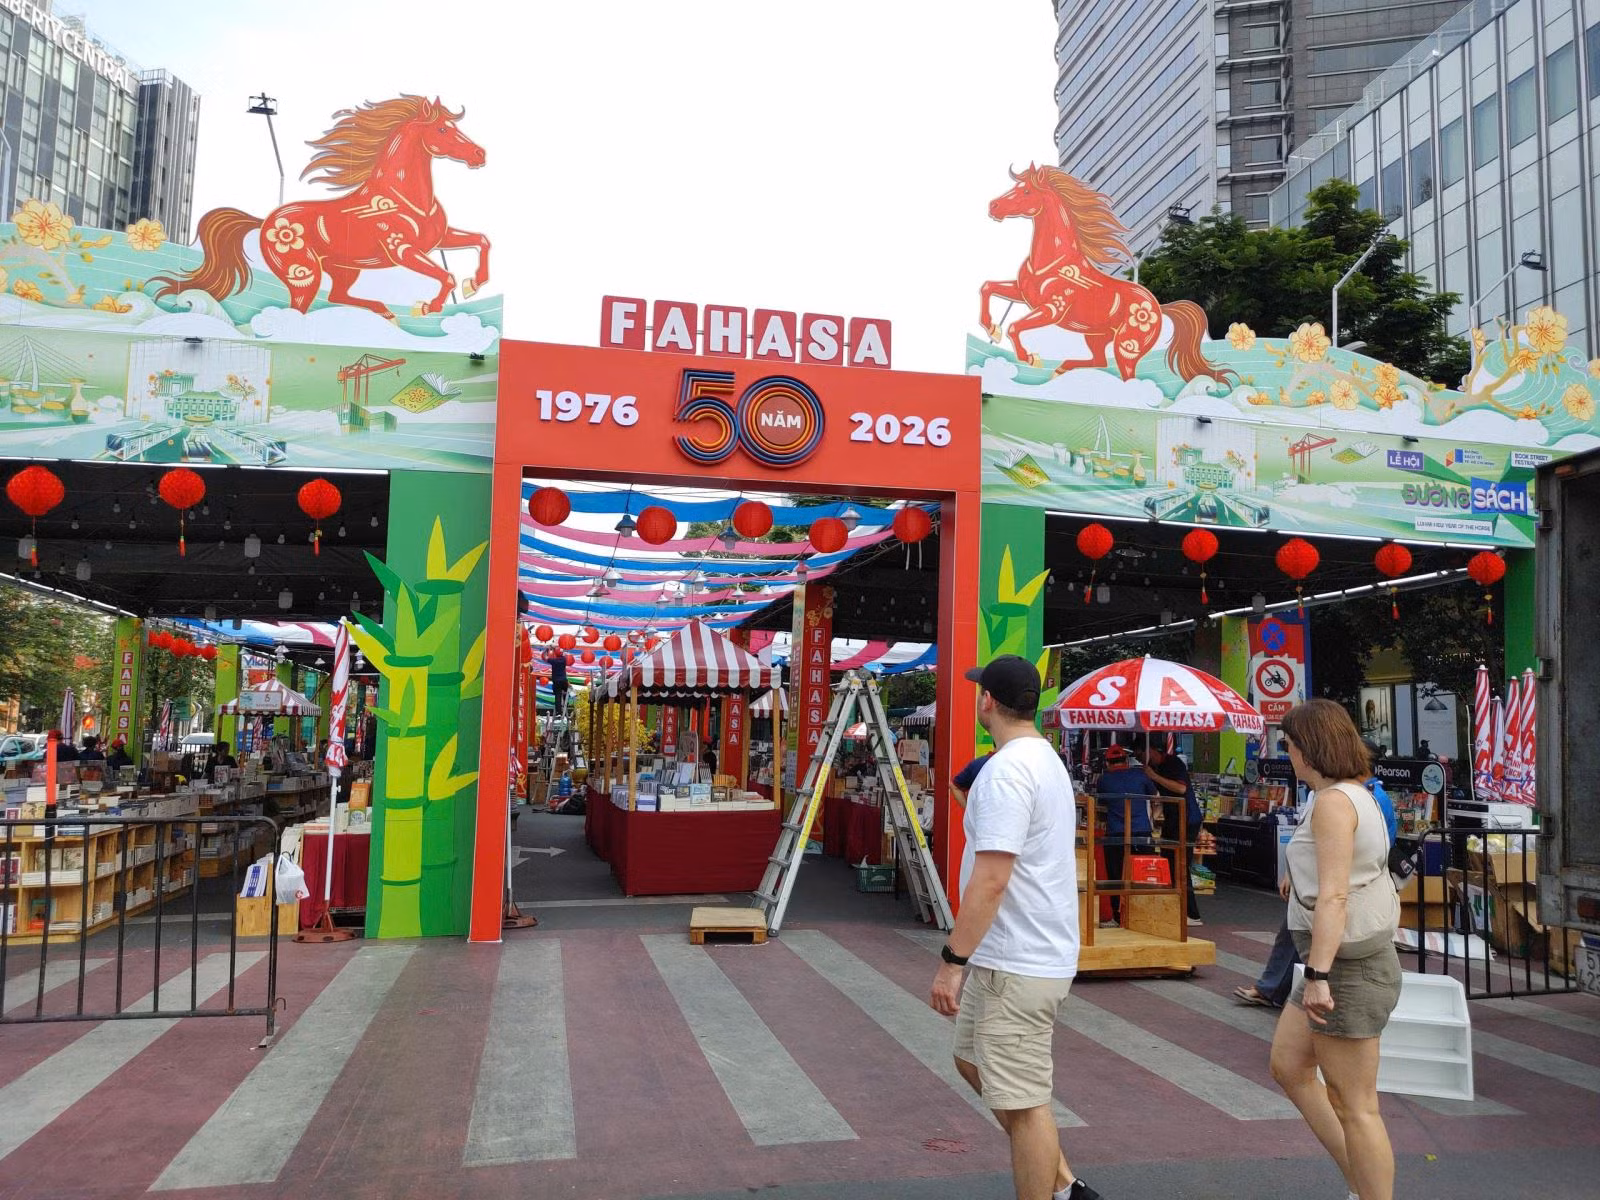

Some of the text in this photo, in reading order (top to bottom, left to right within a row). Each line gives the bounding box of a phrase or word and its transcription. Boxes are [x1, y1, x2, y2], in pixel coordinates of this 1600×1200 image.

[0, 0, 132, 94] IBERTY CENTRAL
[610, 301, 888, 365] FAHASA
[536, 390, 639, 426] 1976
[672, 368, 825, 469] 50
[760, 410, 801, 429] NĂM
[849, 412, 951, 447] 2026
[1403, 455, 1420, 469] HỘI
[1473, 483, 1525, 512] SÁCH
[119, 652, 133, 744] FAHASA
[809, 629, 823, 743] FAHASA
[1070, 710, 1126, 725] FAHASA
[1150, 711, 1215, 728] FAHASA
[1232, 714, 1262, 731] FAHASA
[1377, 765, 1410, 778] Pearson
